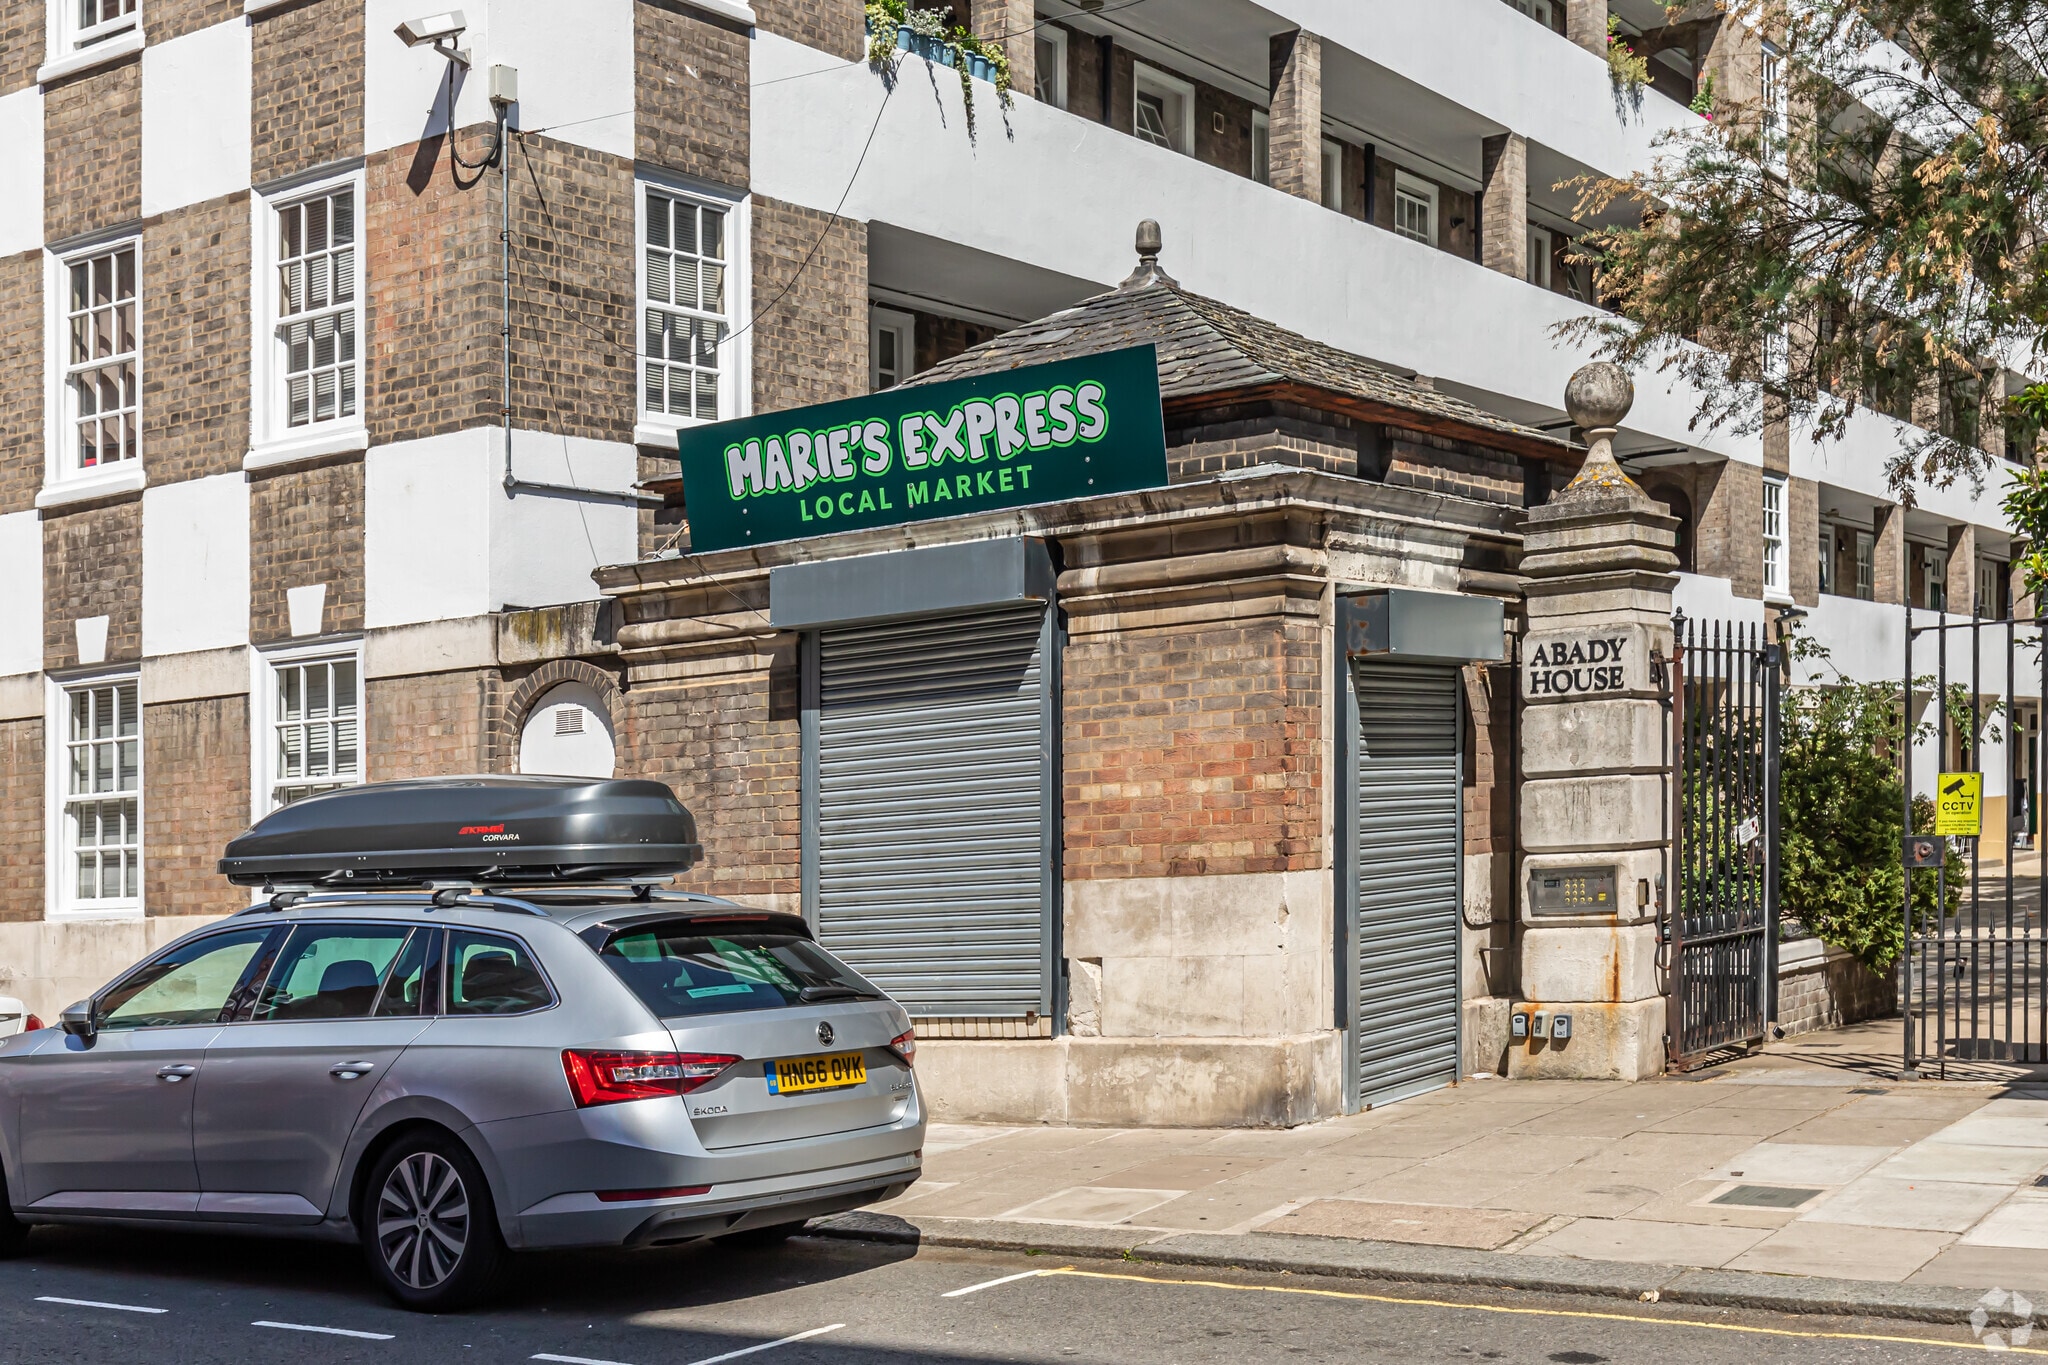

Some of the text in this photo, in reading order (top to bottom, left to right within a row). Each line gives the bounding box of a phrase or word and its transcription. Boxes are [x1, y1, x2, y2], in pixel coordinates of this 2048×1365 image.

[725, 380, 1109, 500] MARIE'S EXPRESS
[800, 464, 1033, 522] LOCAL MARKET
[1529, 638, 1628, 667] ABADY
[1529, 666, 1625, 694] HOUSE
[1942, 801, 1974, 811] CCTV
[482, 833, 520, 842] CORVARA
[779, 1055, 864, 1088] HN66 OVK
